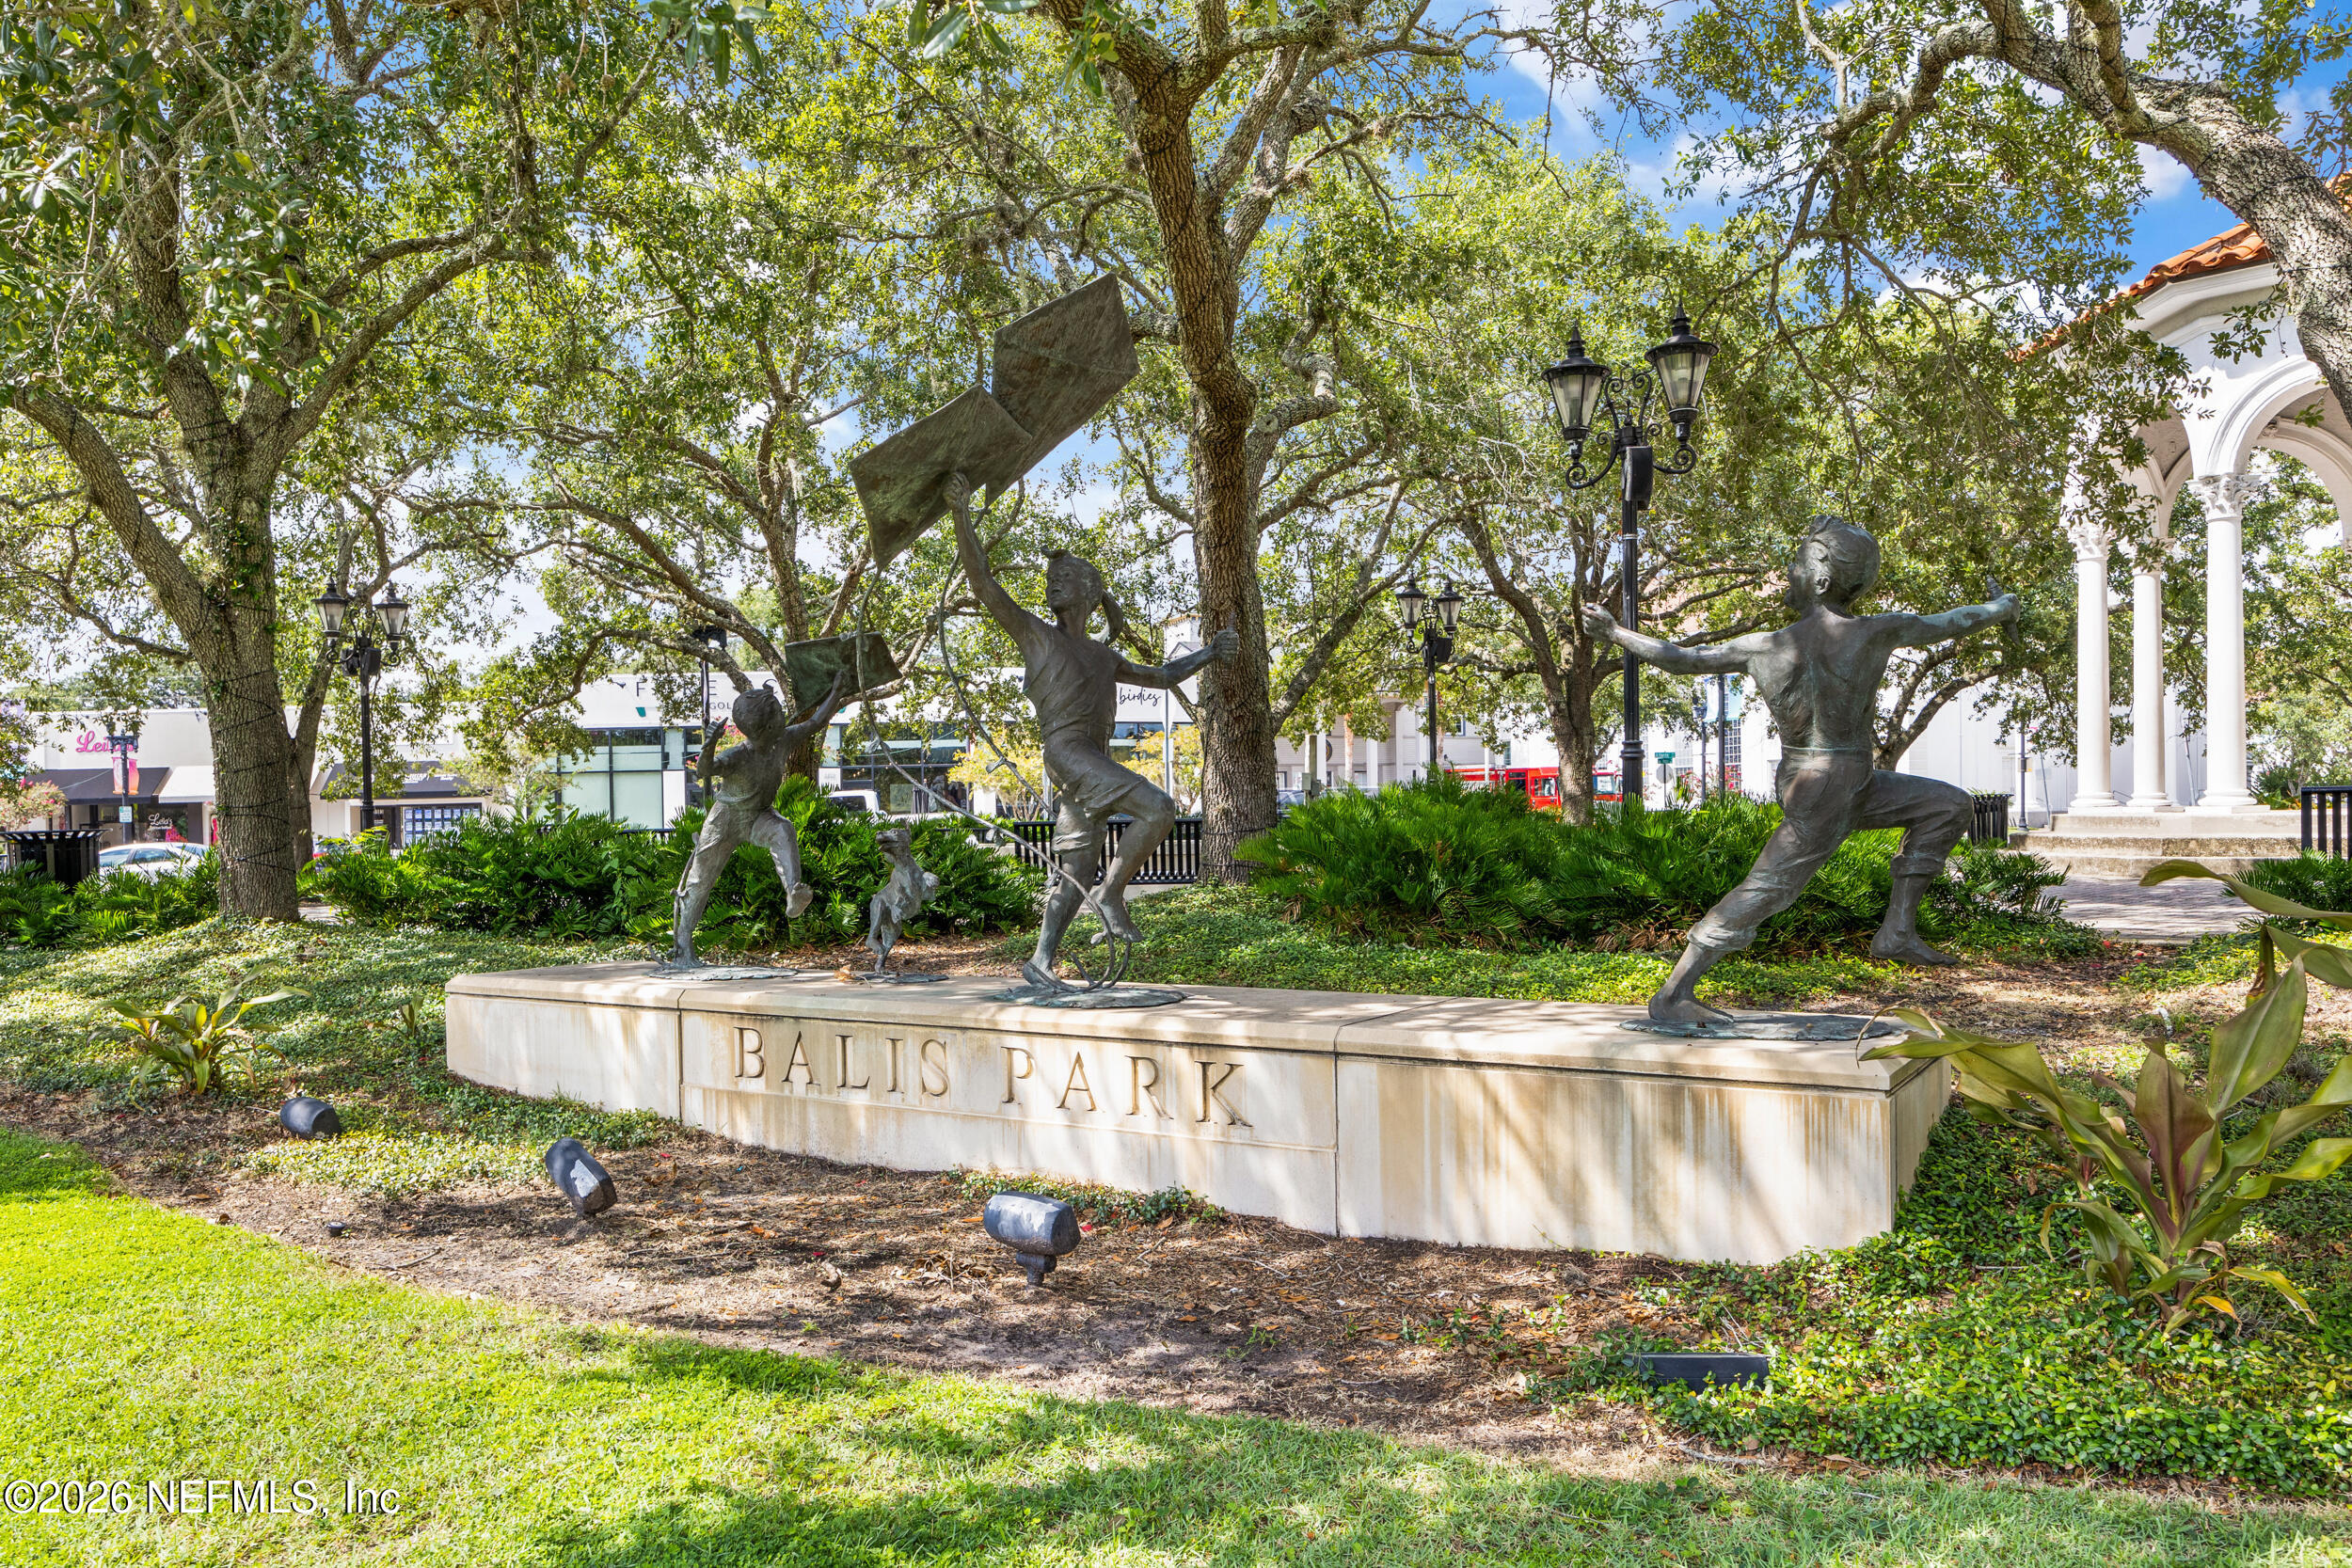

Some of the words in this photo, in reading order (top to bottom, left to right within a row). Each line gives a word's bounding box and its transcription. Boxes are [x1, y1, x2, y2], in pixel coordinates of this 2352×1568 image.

[636, 680, 717, 696] FRE
[1120, 686, 1161, 706] birdies
[732, 1025, 949, 1098] BALIS
[1000, 1045, 1253, 1128] PARK
